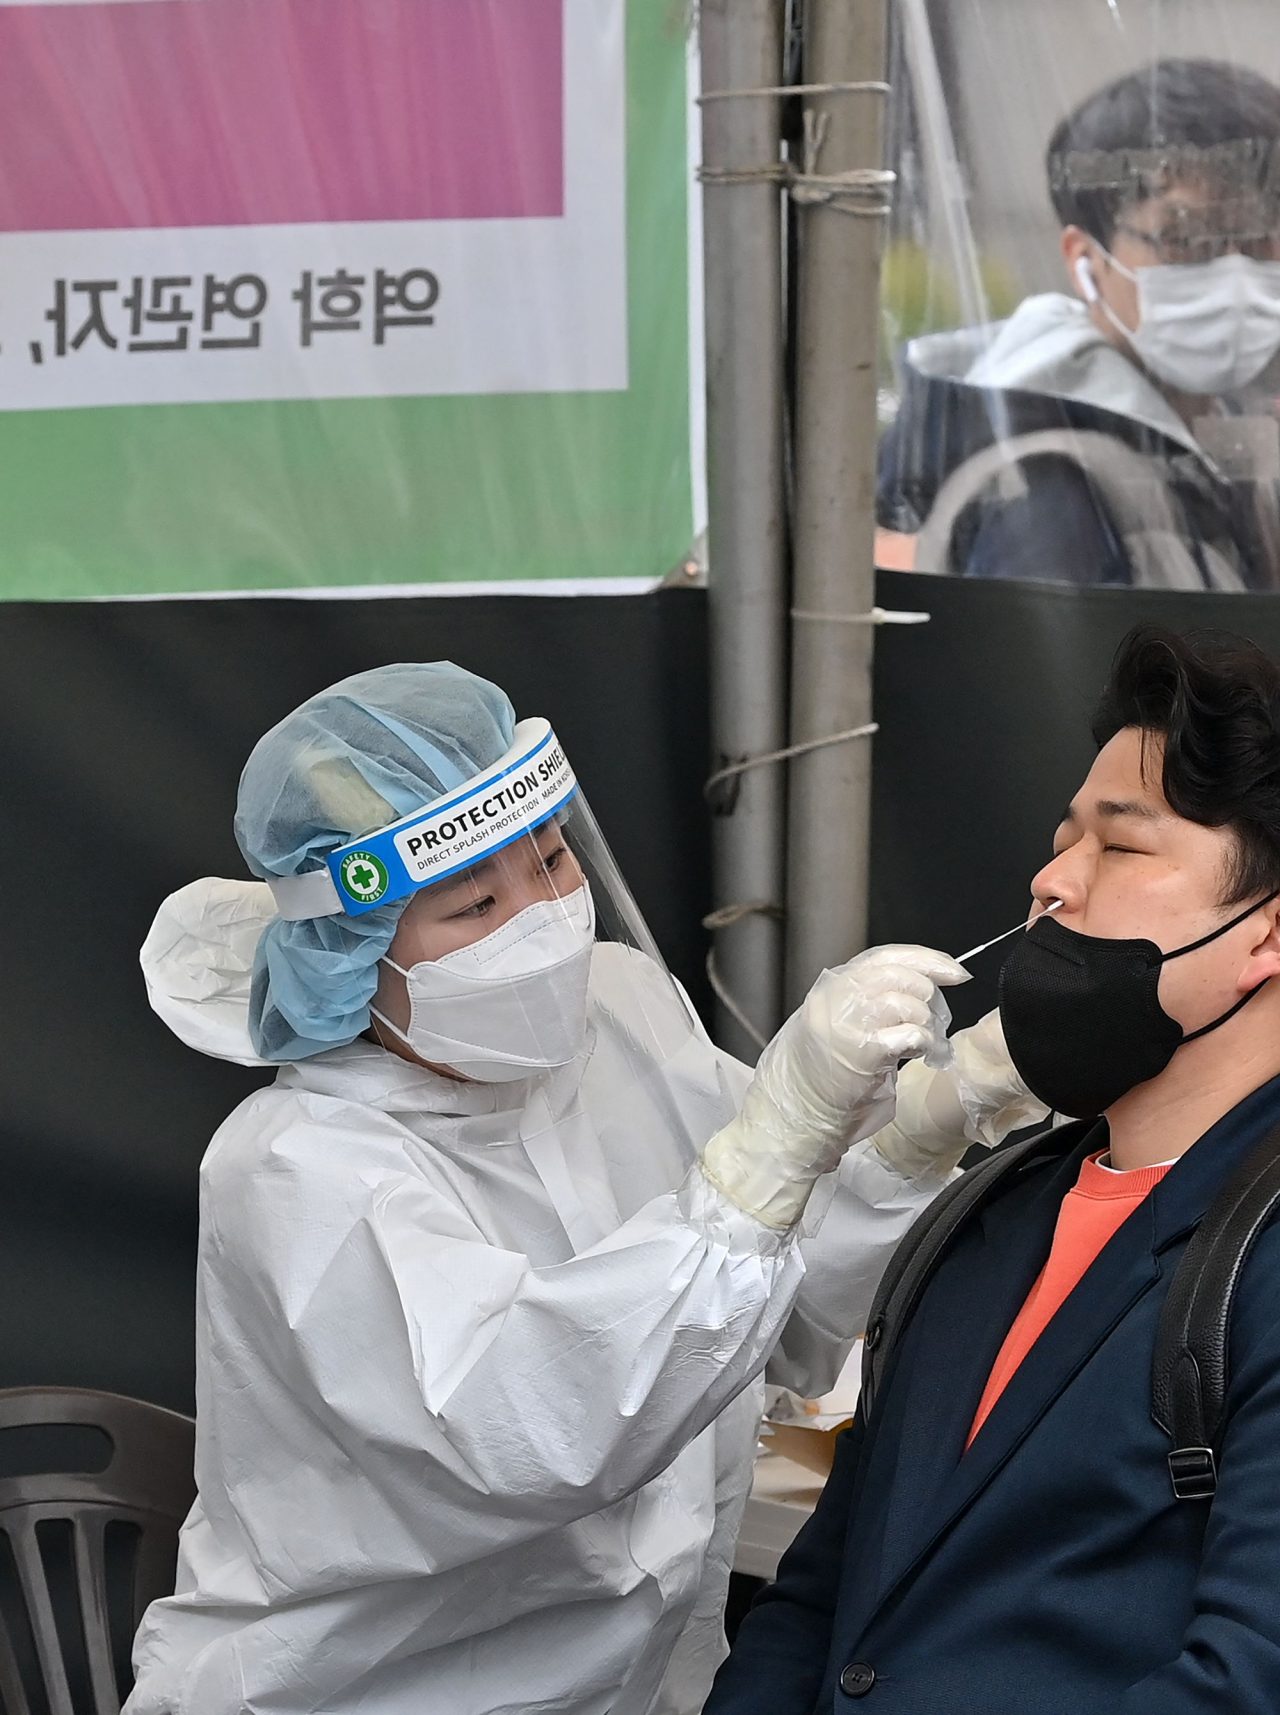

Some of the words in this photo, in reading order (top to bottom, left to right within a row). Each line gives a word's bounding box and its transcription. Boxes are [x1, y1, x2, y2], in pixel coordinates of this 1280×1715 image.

[406, 771, 539, 857] PROTECTION
[538, 745, 566, 781] SHIEL
[417, 848, 452, 870] DIRECT
[454, 829, 489, 854] SPLASH
[490, 797, 540, 833] PROTECTION
[541, 783, 558, 799] MADE
[342, 853, 370, 868] SAFETY
[361, 887, 383, 901] FIRST
